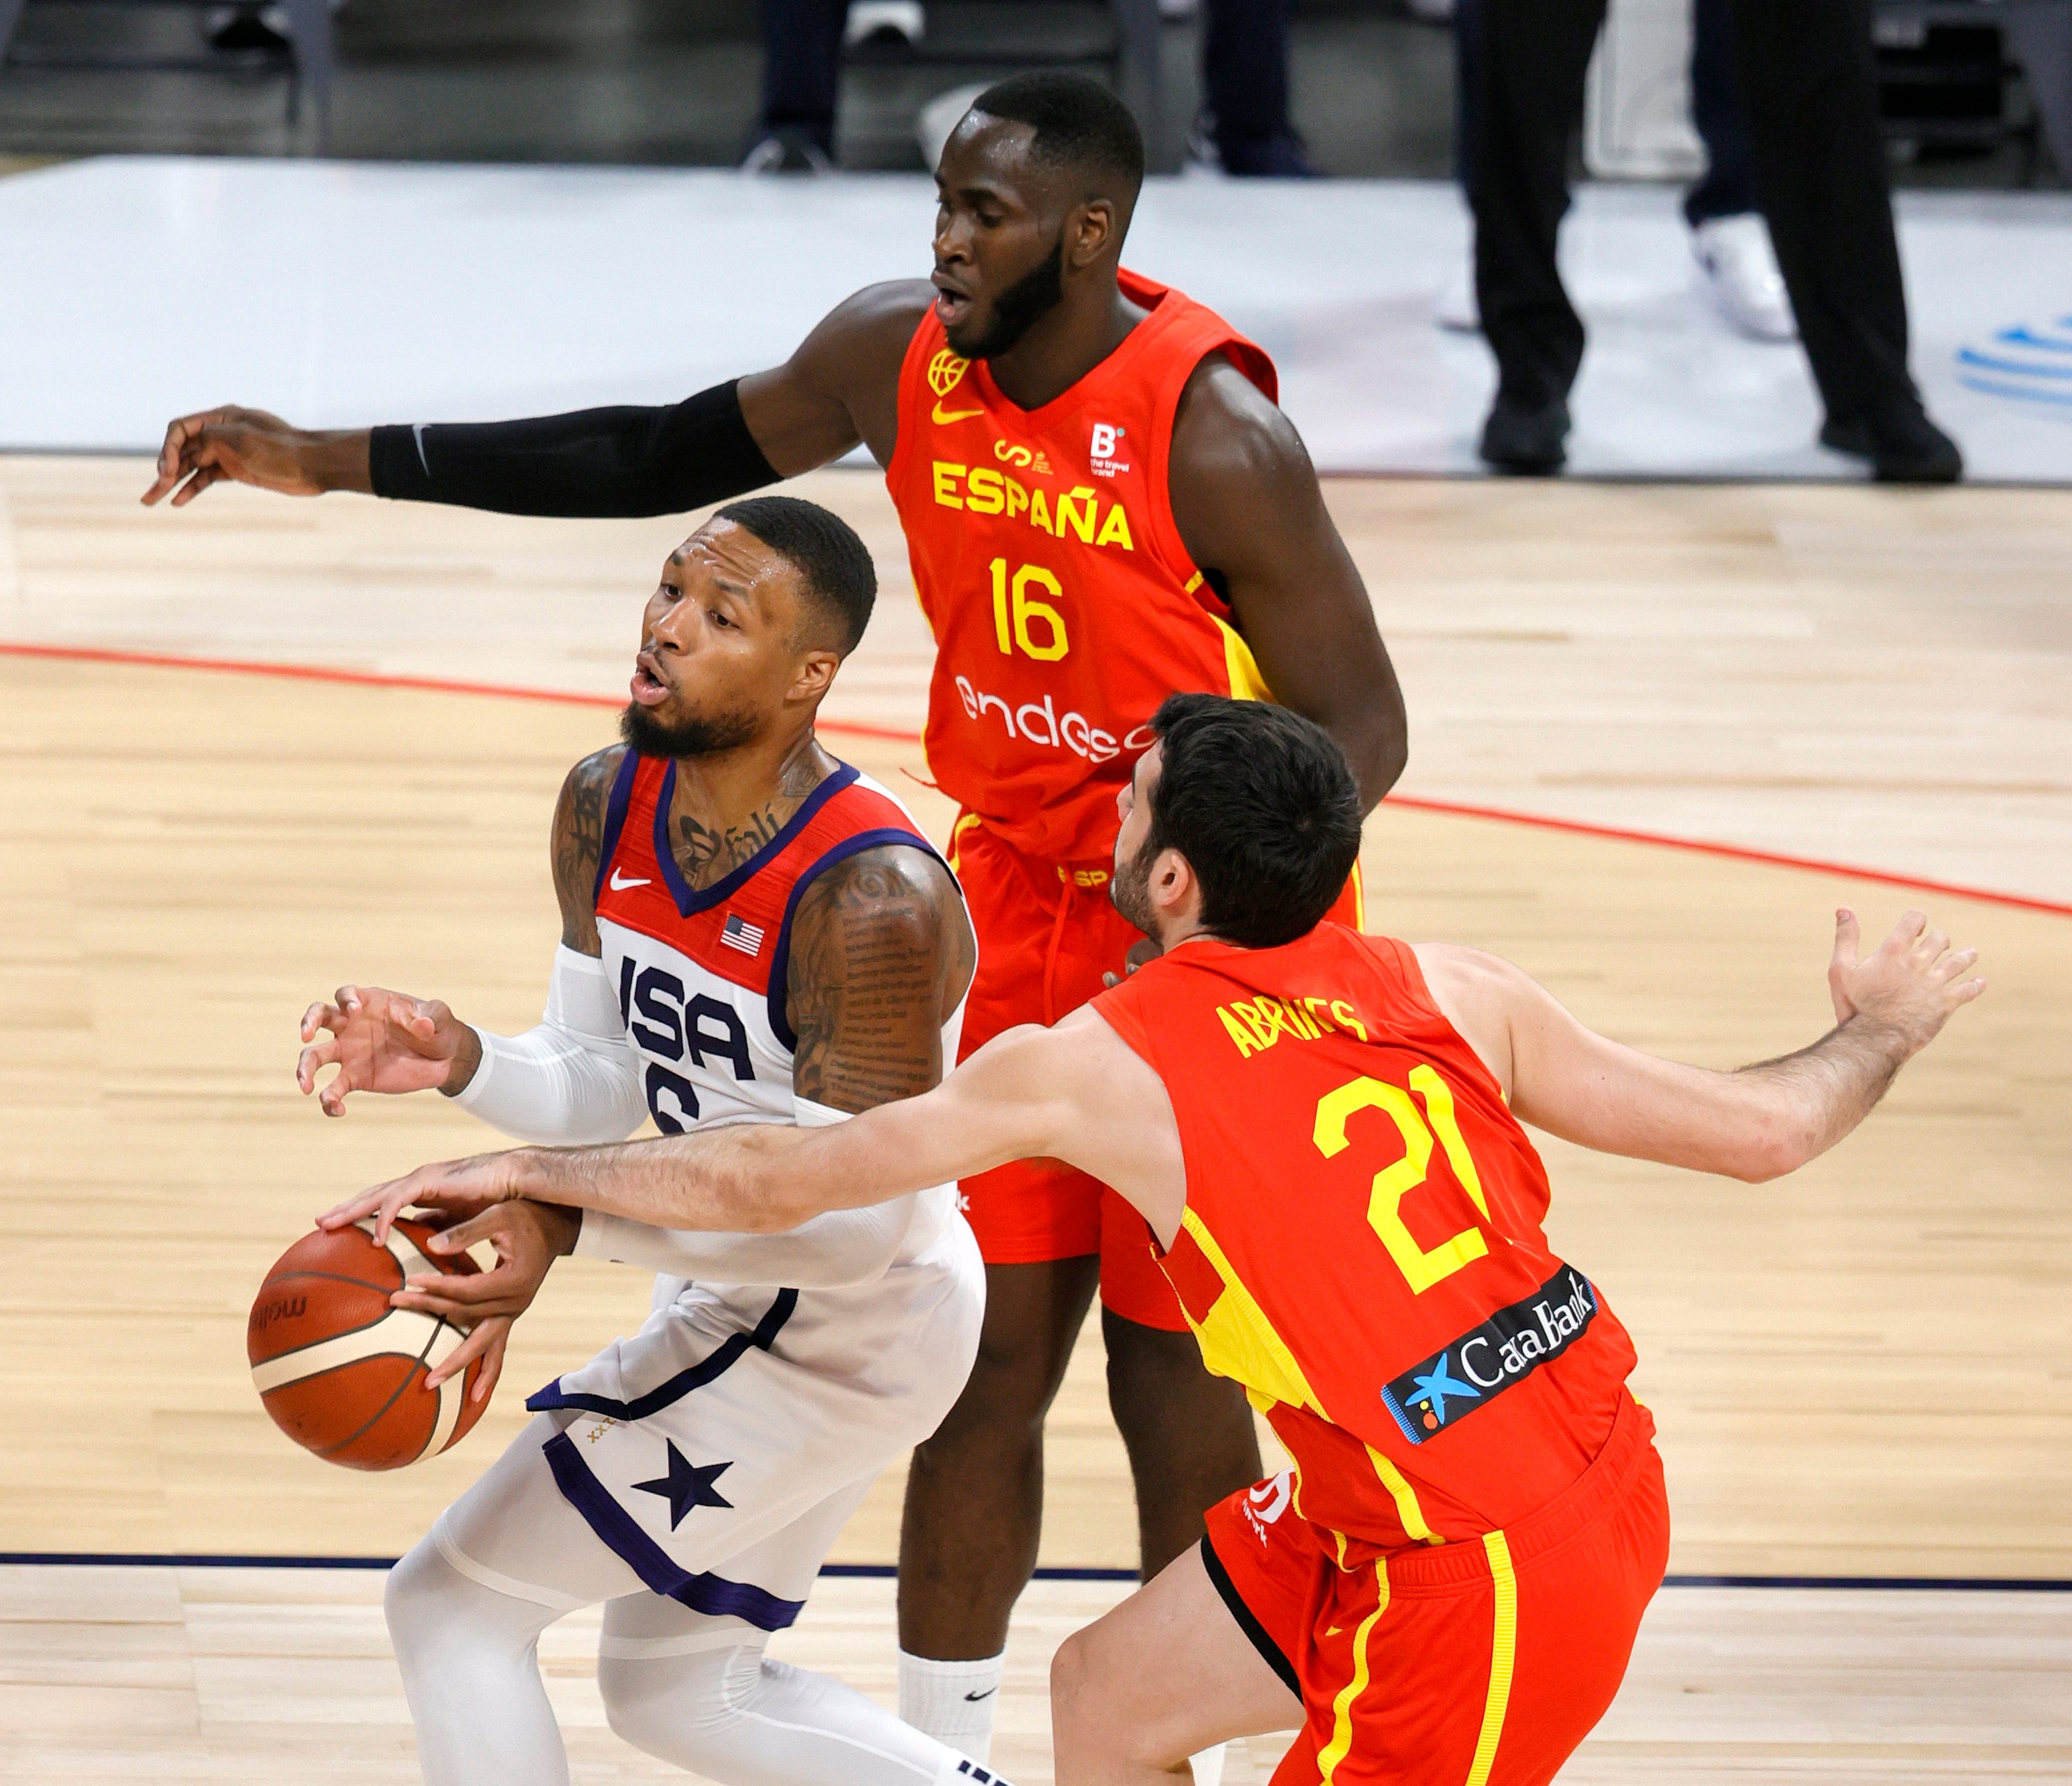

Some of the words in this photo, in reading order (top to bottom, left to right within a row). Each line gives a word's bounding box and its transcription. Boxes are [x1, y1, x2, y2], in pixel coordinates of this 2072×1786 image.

[932, 460, 1134, 551] ESPAÑA
[1105, 459, 1130, 473] travel
[989, 558, 1069, 662] 16
[1312, 1063, 1513, 1296] 21
